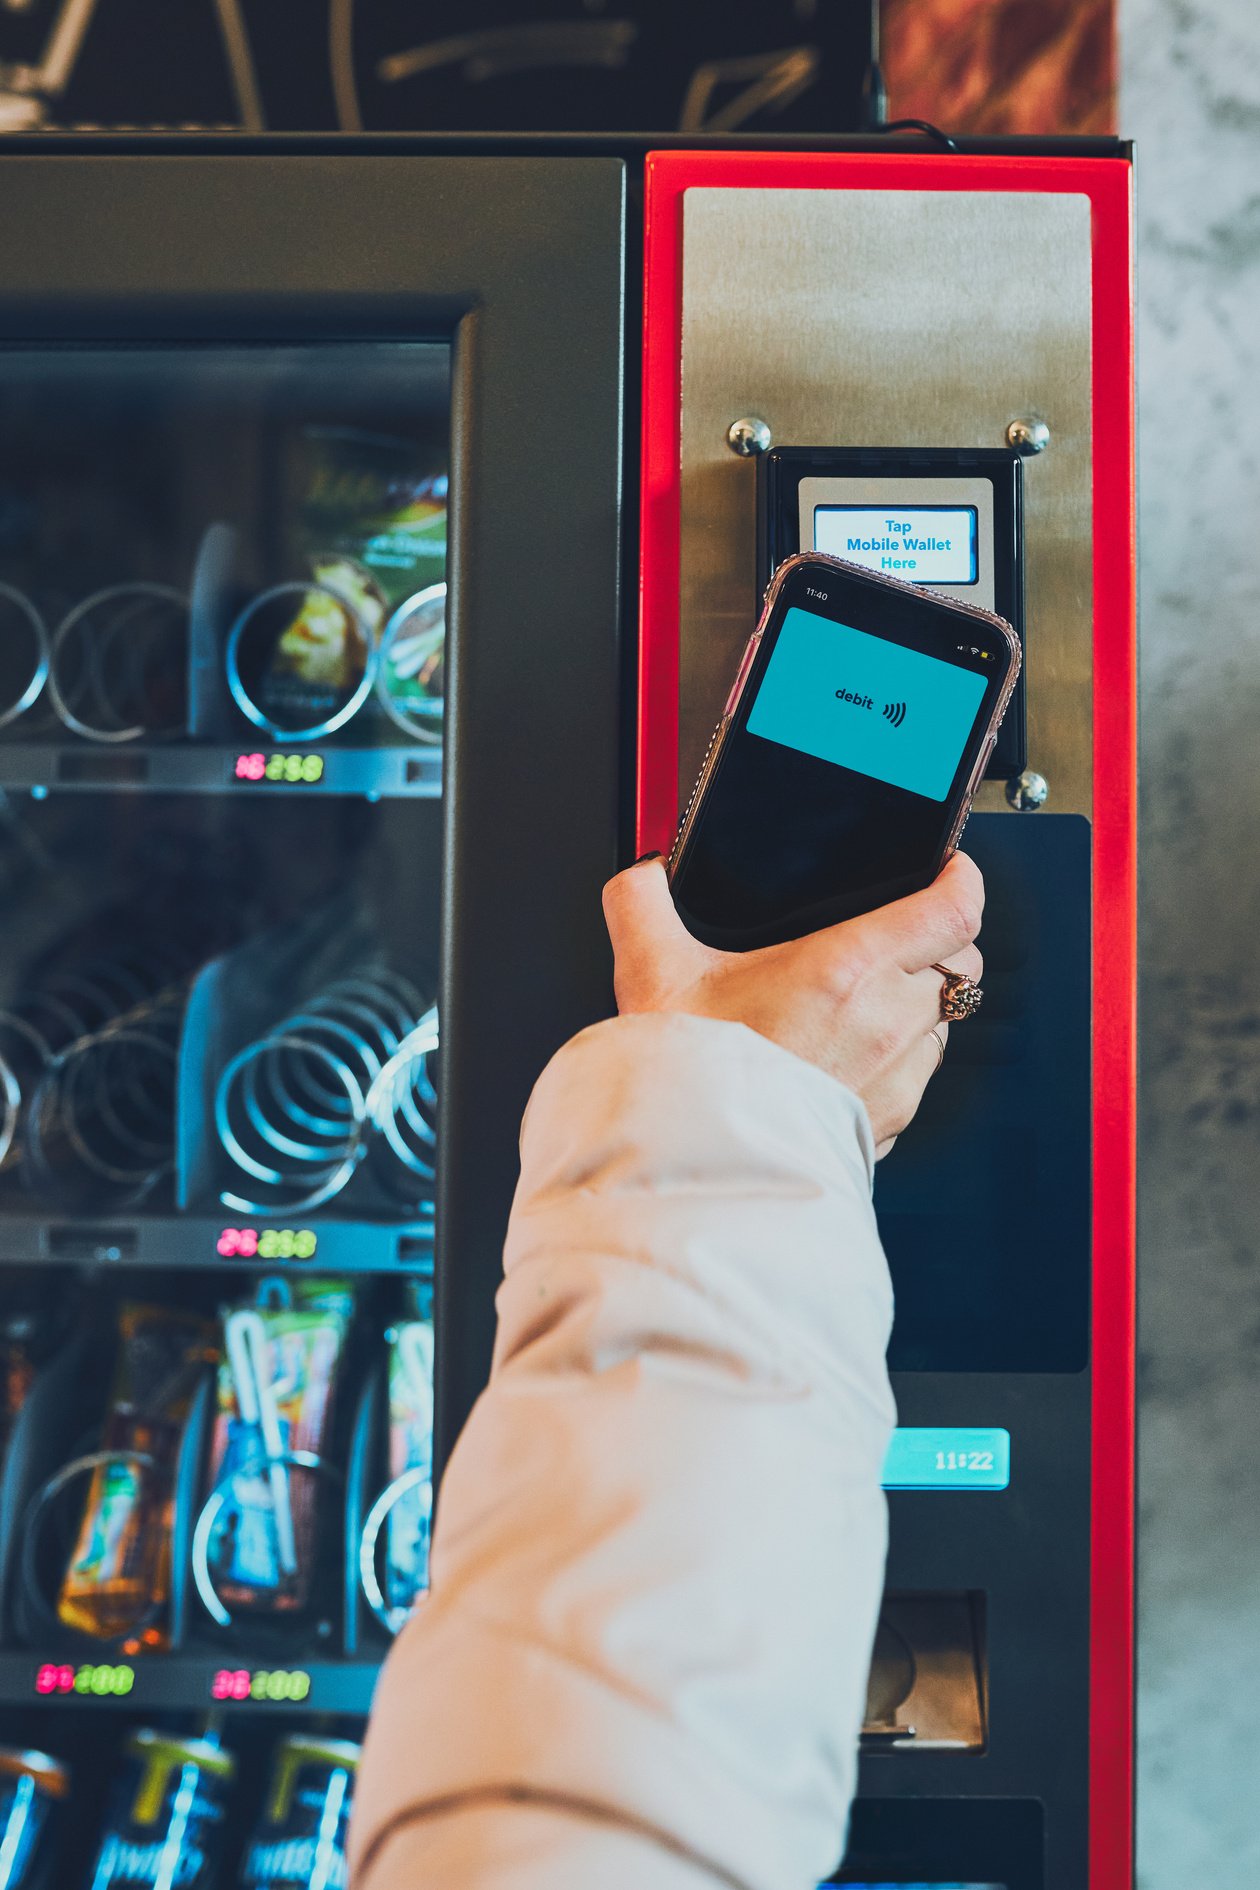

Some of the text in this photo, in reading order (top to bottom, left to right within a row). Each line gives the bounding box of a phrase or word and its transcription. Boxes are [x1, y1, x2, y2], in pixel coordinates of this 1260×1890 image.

[885, 520, 912, 535] Tap
[847, 538, 951, 551] Mobile Wallet
[881, 557, 917, 569] Here
[806, 587, 828, 601] 11:40
[835, 688, 874, 710] debit
[935, 1451, 994, 1470] 11:22
